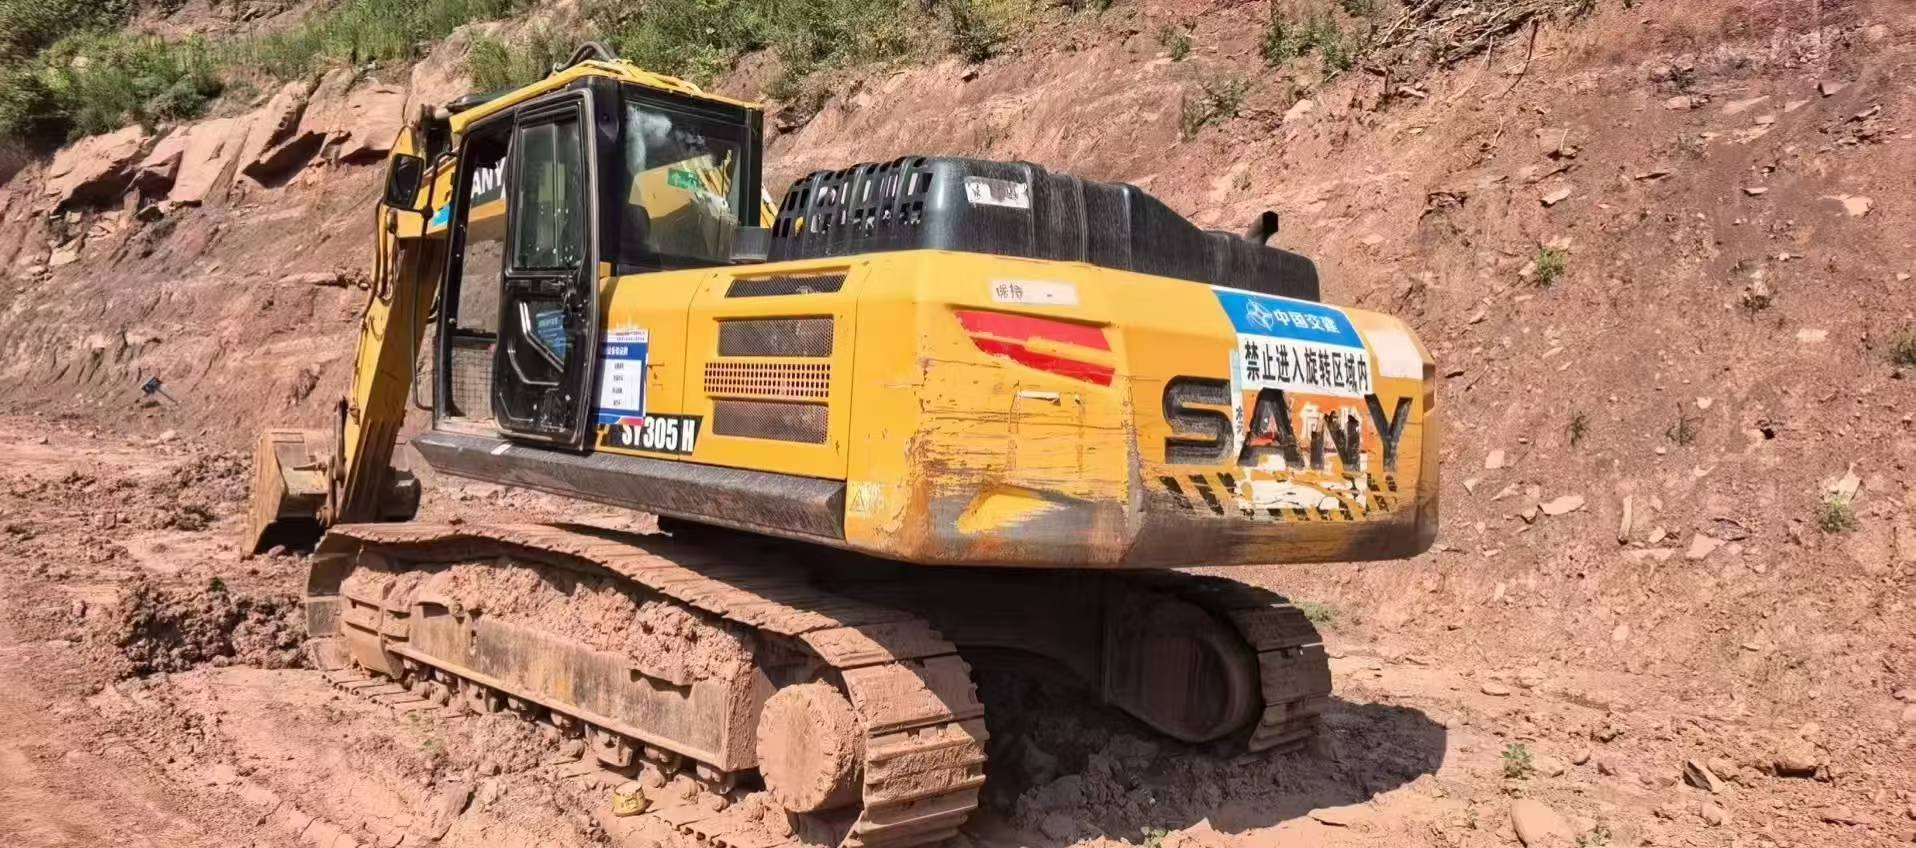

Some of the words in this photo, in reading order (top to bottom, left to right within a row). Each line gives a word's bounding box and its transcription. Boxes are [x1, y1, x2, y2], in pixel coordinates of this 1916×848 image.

[471, 157, 507, 199] ANY
[1273, 308, 1341, 334] 中国交建
[1244, 340, 1369, 393] 禁止进入旋转区域内
[1162, 374, 1414, 471] SANY
